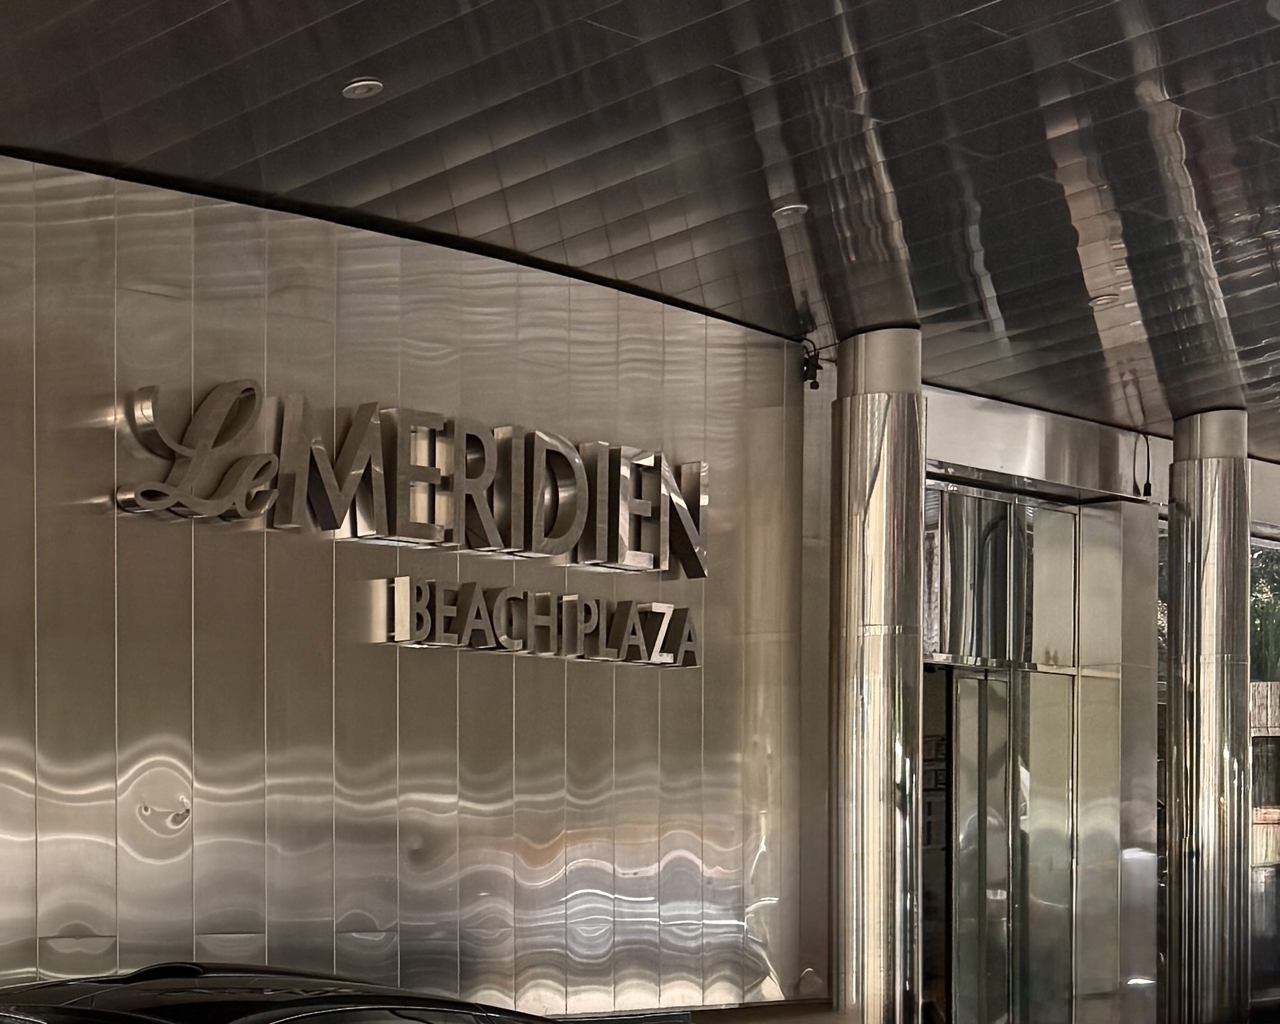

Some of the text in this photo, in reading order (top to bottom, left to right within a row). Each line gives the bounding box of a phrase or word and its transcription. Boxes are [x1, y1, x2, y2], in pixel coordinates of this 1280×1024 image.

[117, 379, 708, 579] Le MERIDIEN
[397, 577, 702, 667] BEACH PLAZA
